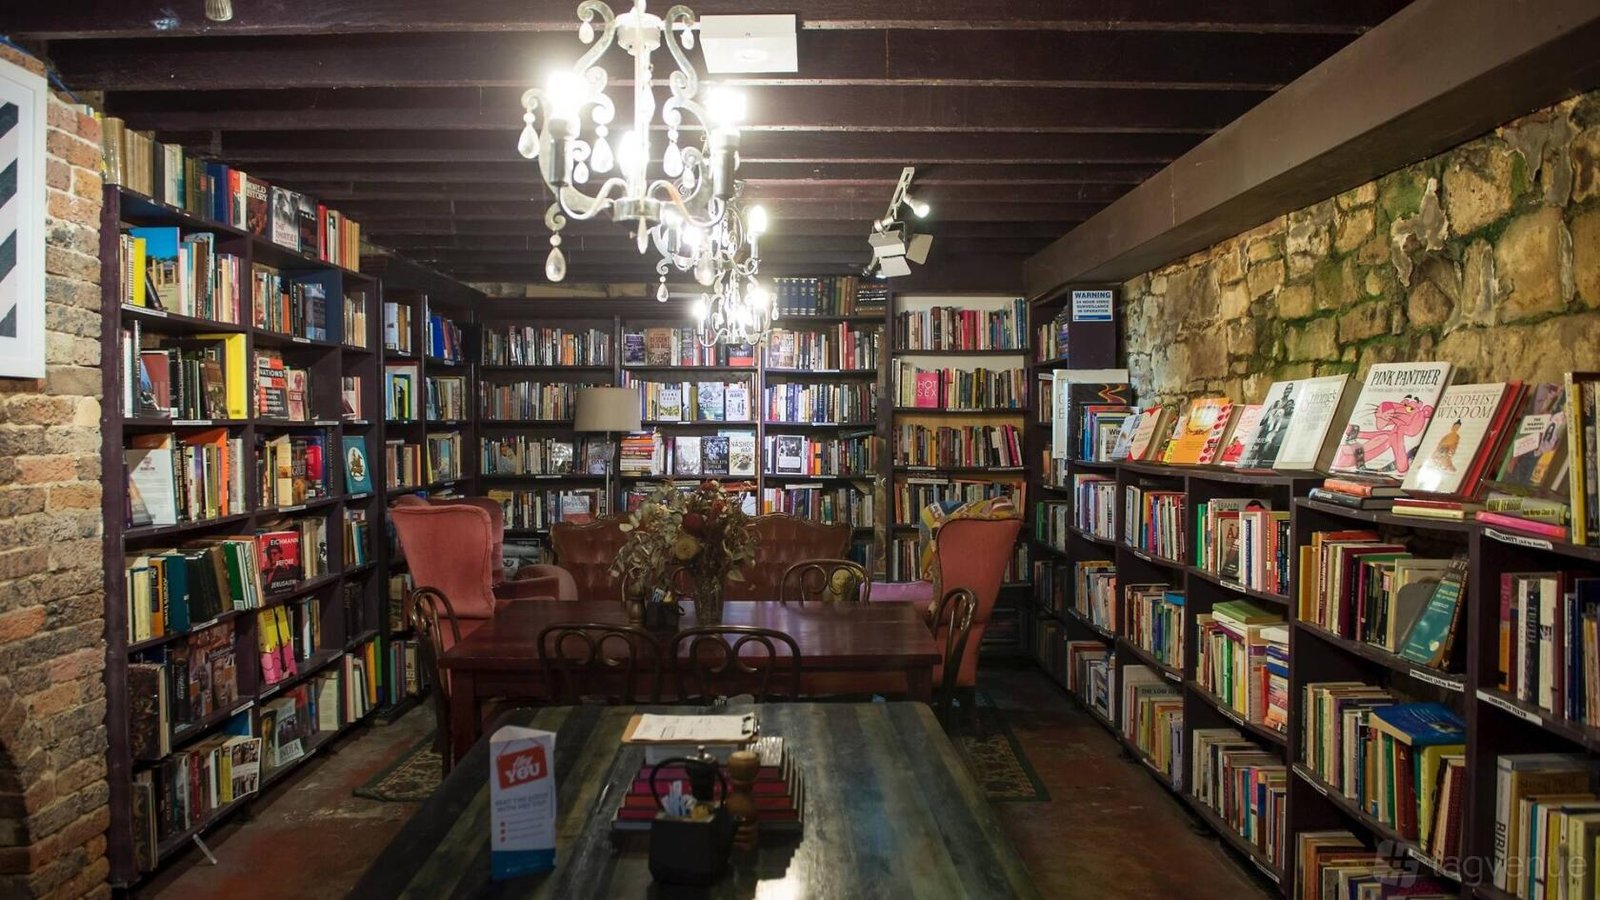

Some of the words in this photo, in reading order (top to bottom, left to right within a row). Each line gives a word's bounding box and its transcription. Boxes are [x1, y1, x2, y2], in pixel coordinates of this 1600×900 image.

[1074, 291, 1111, 299] WARNING
[259, 369, 284, 378] NATIONS
[1370, 370, 1396, 386] PINK
[1395, 369, 1441, 386] PANTHER
[917, 380, 937, 390] HOT
[917, 388, 937, 397] SEX
[1441, 394, 1500, 406] BUDDHIST
[1437, 406, 1494, 419] WISDOM
[505, 762, 540, 784] YOU
